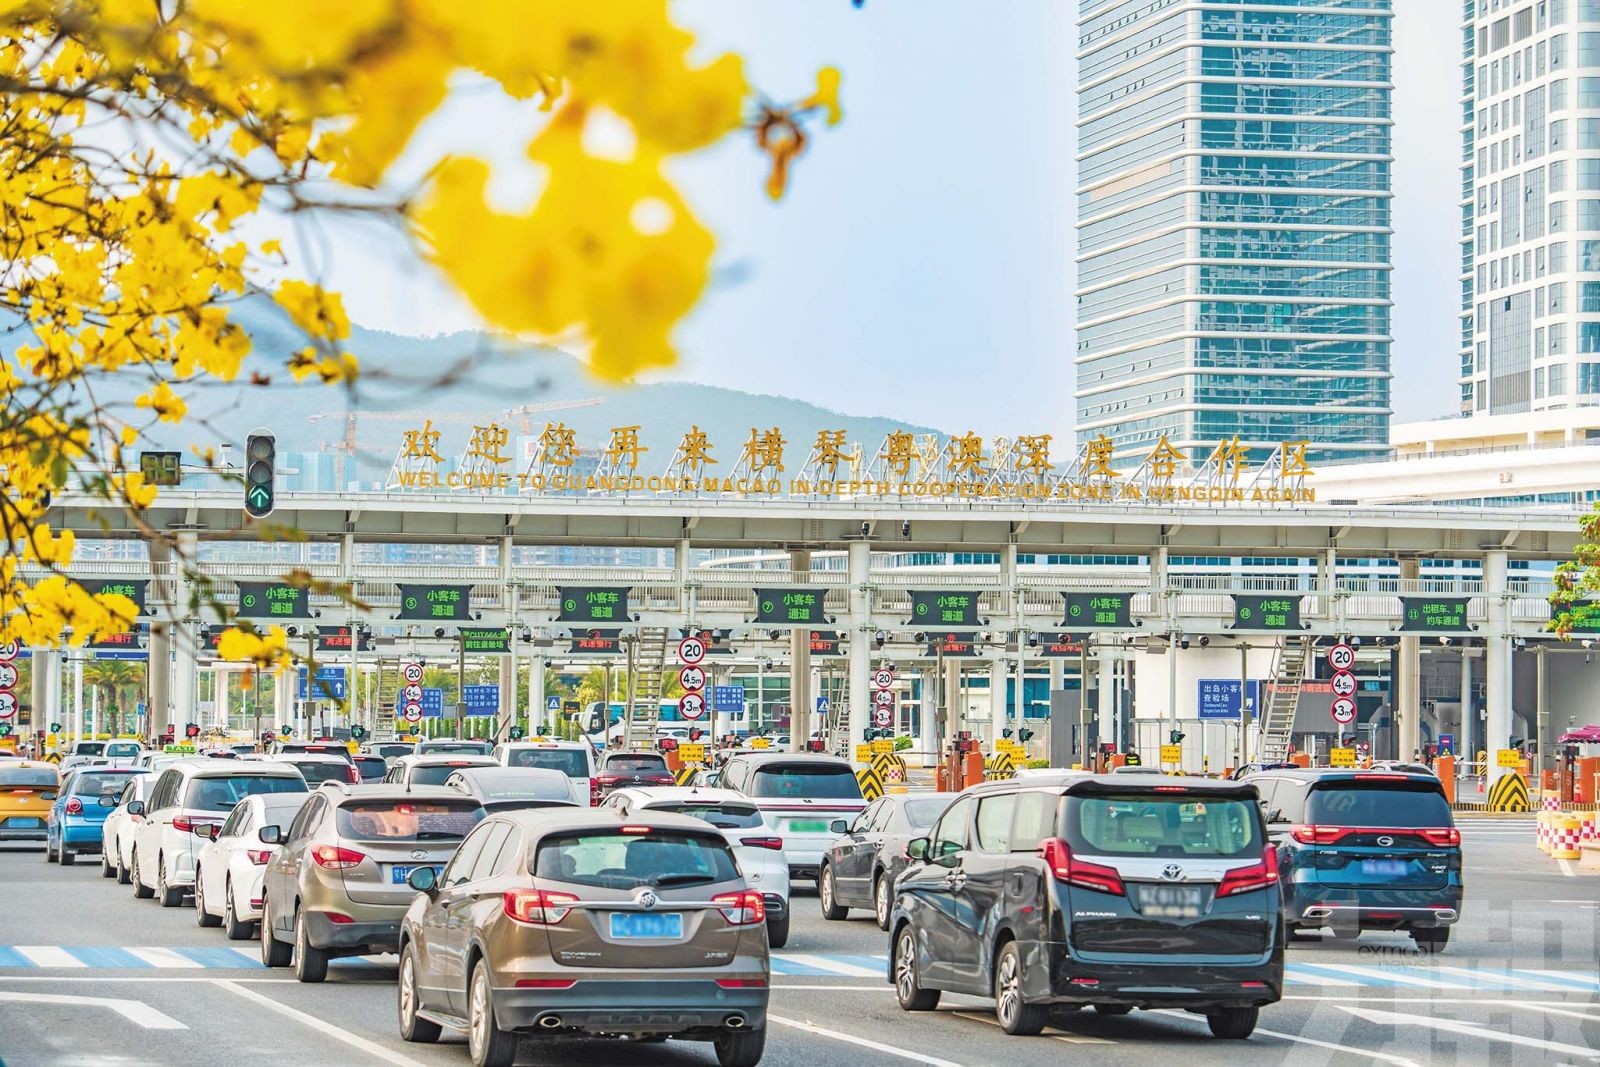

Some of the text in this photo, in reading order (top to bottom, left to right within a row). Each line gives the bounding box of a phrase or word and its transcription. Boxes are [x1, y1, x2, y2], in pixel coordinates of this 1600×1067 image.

[402, 419, 1315, 481] 欢迎您再来横琴粤澳深度合作区
[399, 471, 508, 488] WELCOME
[517, 473, 546, 490] TO
[900, 481, 1051, 498] COOPERATION
[1058, 484, 1111, 499] ZONE
[1122, 485, 1142, 499] IN
[1150, 485, 1244, 501] HENGQIN
[1252, 487, 1315, 502] AGAIN
[265, 587, 299, 599] 小客车
[427, 590, 460, 602] 小客车
[586, 592, 619, 604] 小客车
[783, 594, 816, 606] 小客车
[937, 596, 969, 608] 小客车
[1090, 598, 1122, 610] 小客车
[1260, 600, 1292, 612] 小客车
[271, 602, 293, 614] 通道
[431, 605, 454, 617] 通道
[591, 606, 613, 618] 通道
[788, 608, 810, 620] 通道
[942, 610, 964, 622] 通道
[1095, 612, 1117, 623] 通道
[1265, 614, 1286, 626] 通道
[1426, 615, 1460, 626] 约车通道
[684, 644, 701, 657] 20
[1335, 651, 1350, 664] 20
[408, 669, 420, 678] 20
[683, 672, 702, 684] 4.5m
[879, 674, 890, 684] 20
[1335, 678, 1352, 690] 4.5m
[1203, 694, 1230, 703] 查验场
[408, 708, 418, 716] 3m
[685, 701, 700, 712] 3m
[1337, 705, 1351, 717] 3m
